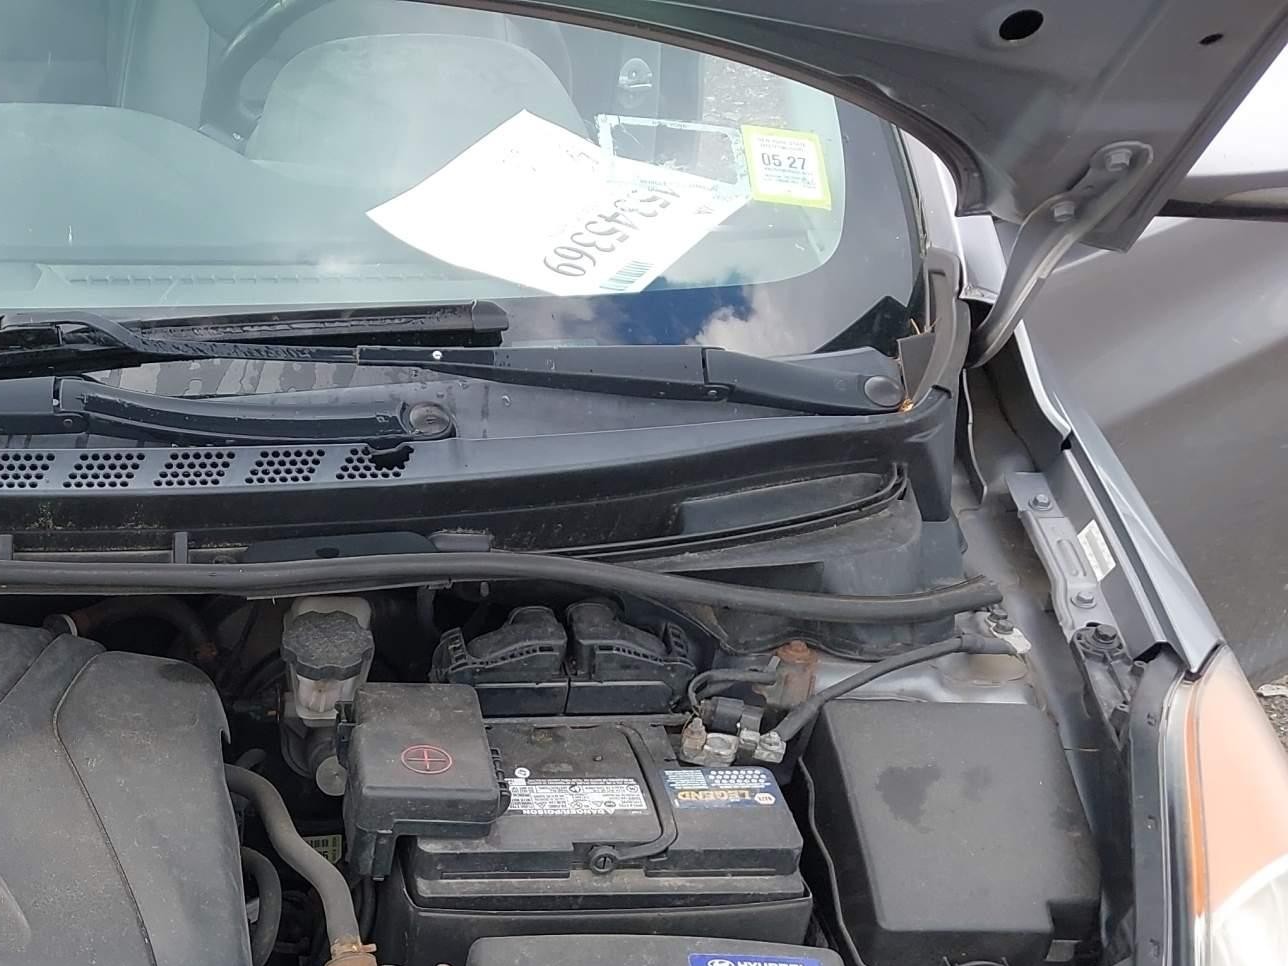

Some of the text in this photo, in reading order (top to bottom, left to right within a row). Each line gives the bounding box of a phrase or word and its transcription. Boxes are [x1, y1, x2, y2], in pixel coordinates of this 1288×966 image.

[761, 152, 806, 170] 05 27
[678, 790, 751, 802] LEGEND
